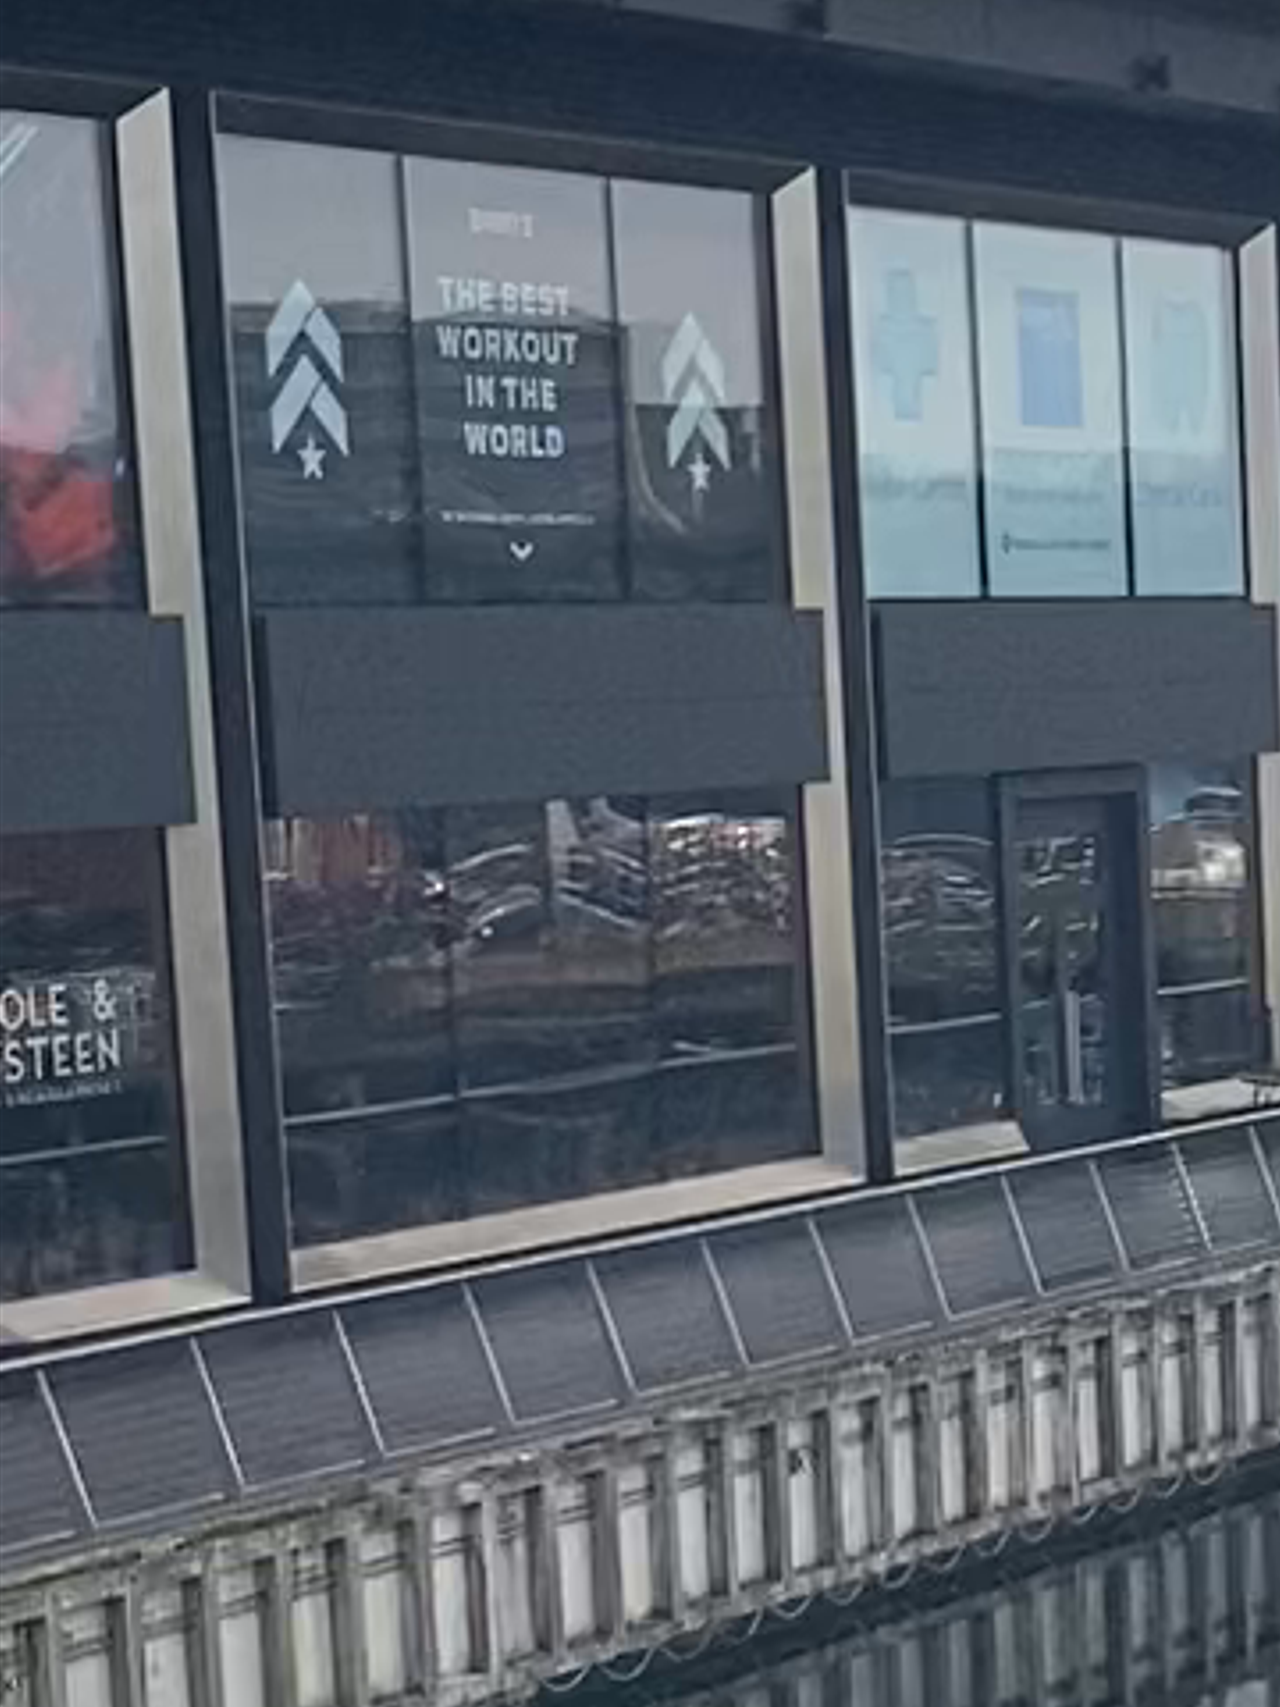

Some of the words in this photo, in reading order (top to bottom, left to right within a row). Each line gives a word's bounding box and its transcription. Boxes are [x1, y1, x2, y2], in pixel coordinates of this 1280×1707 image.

[436, 276, 495, 314] THE
[501, 281, 569, 317] BEST
[436, 325, 579, 367] WORKOUT
[465, 375, 495, 409] IN
[501, 377, 558, 412] THE
[463, 421, 566, 459] WORLD
[0, 983, 69, 1031] OLE
[93, 978, 117, 1022] &
[4, 1028, 120, 1083] STEEN
